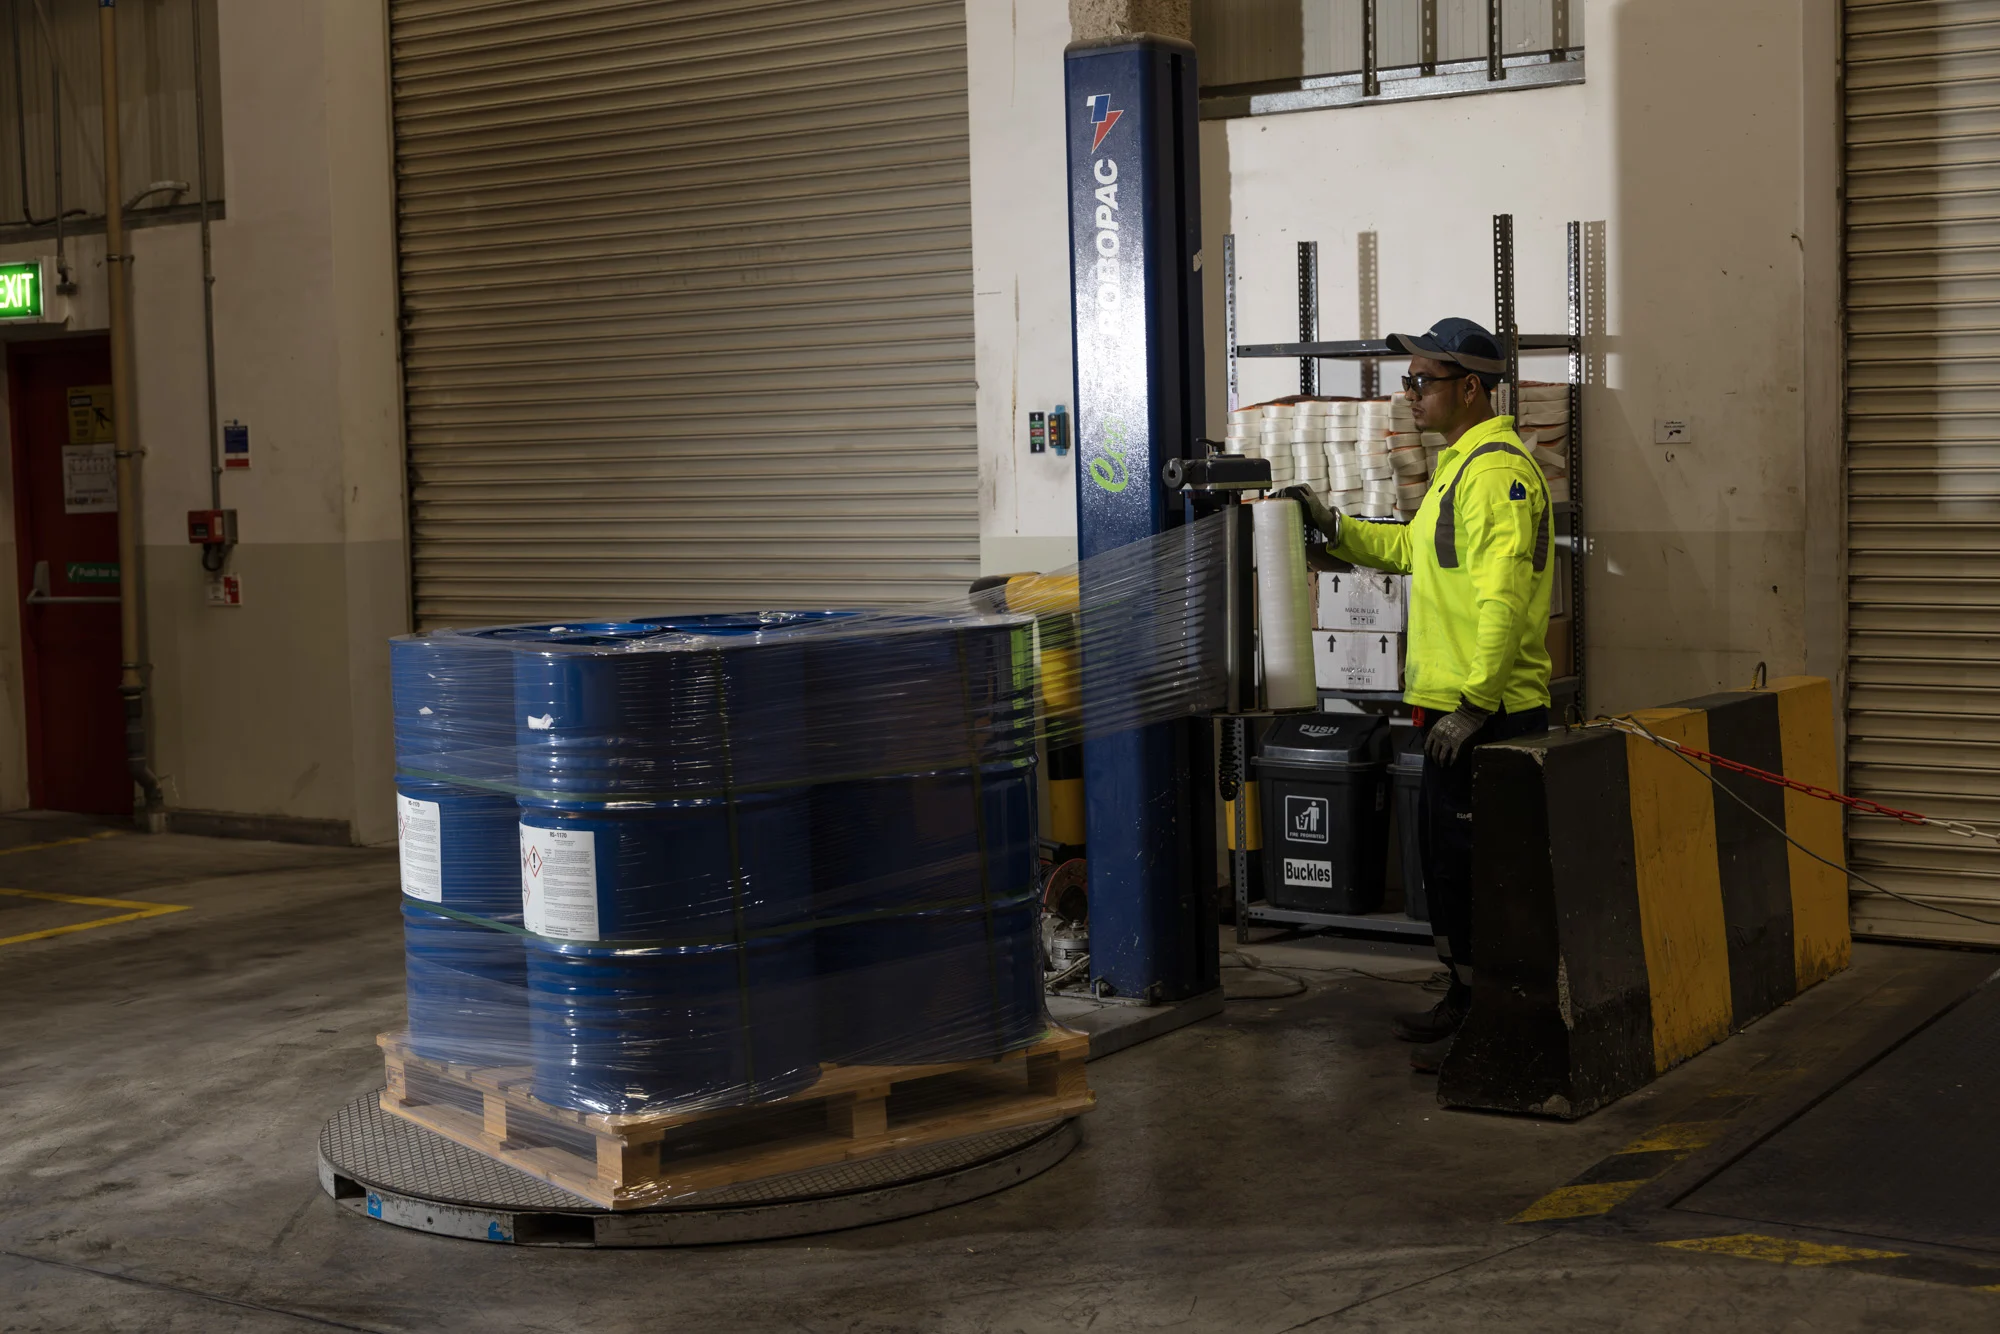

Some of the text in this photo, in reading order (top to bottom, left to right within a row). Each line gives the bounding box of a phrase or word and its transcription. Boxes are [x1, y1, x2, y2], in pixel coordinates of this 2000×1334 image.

[1093, 158, 1121, 336] ROBOPAC
[0, 273, 34, 309] EXIT
[1299, 723, 1340, 735] PUSH
[549, 831, 568, 839] RS-1170
[1300, 832, 1325, 840] PROHIBITED
[1285, 861, 1331, 883] Buckles
